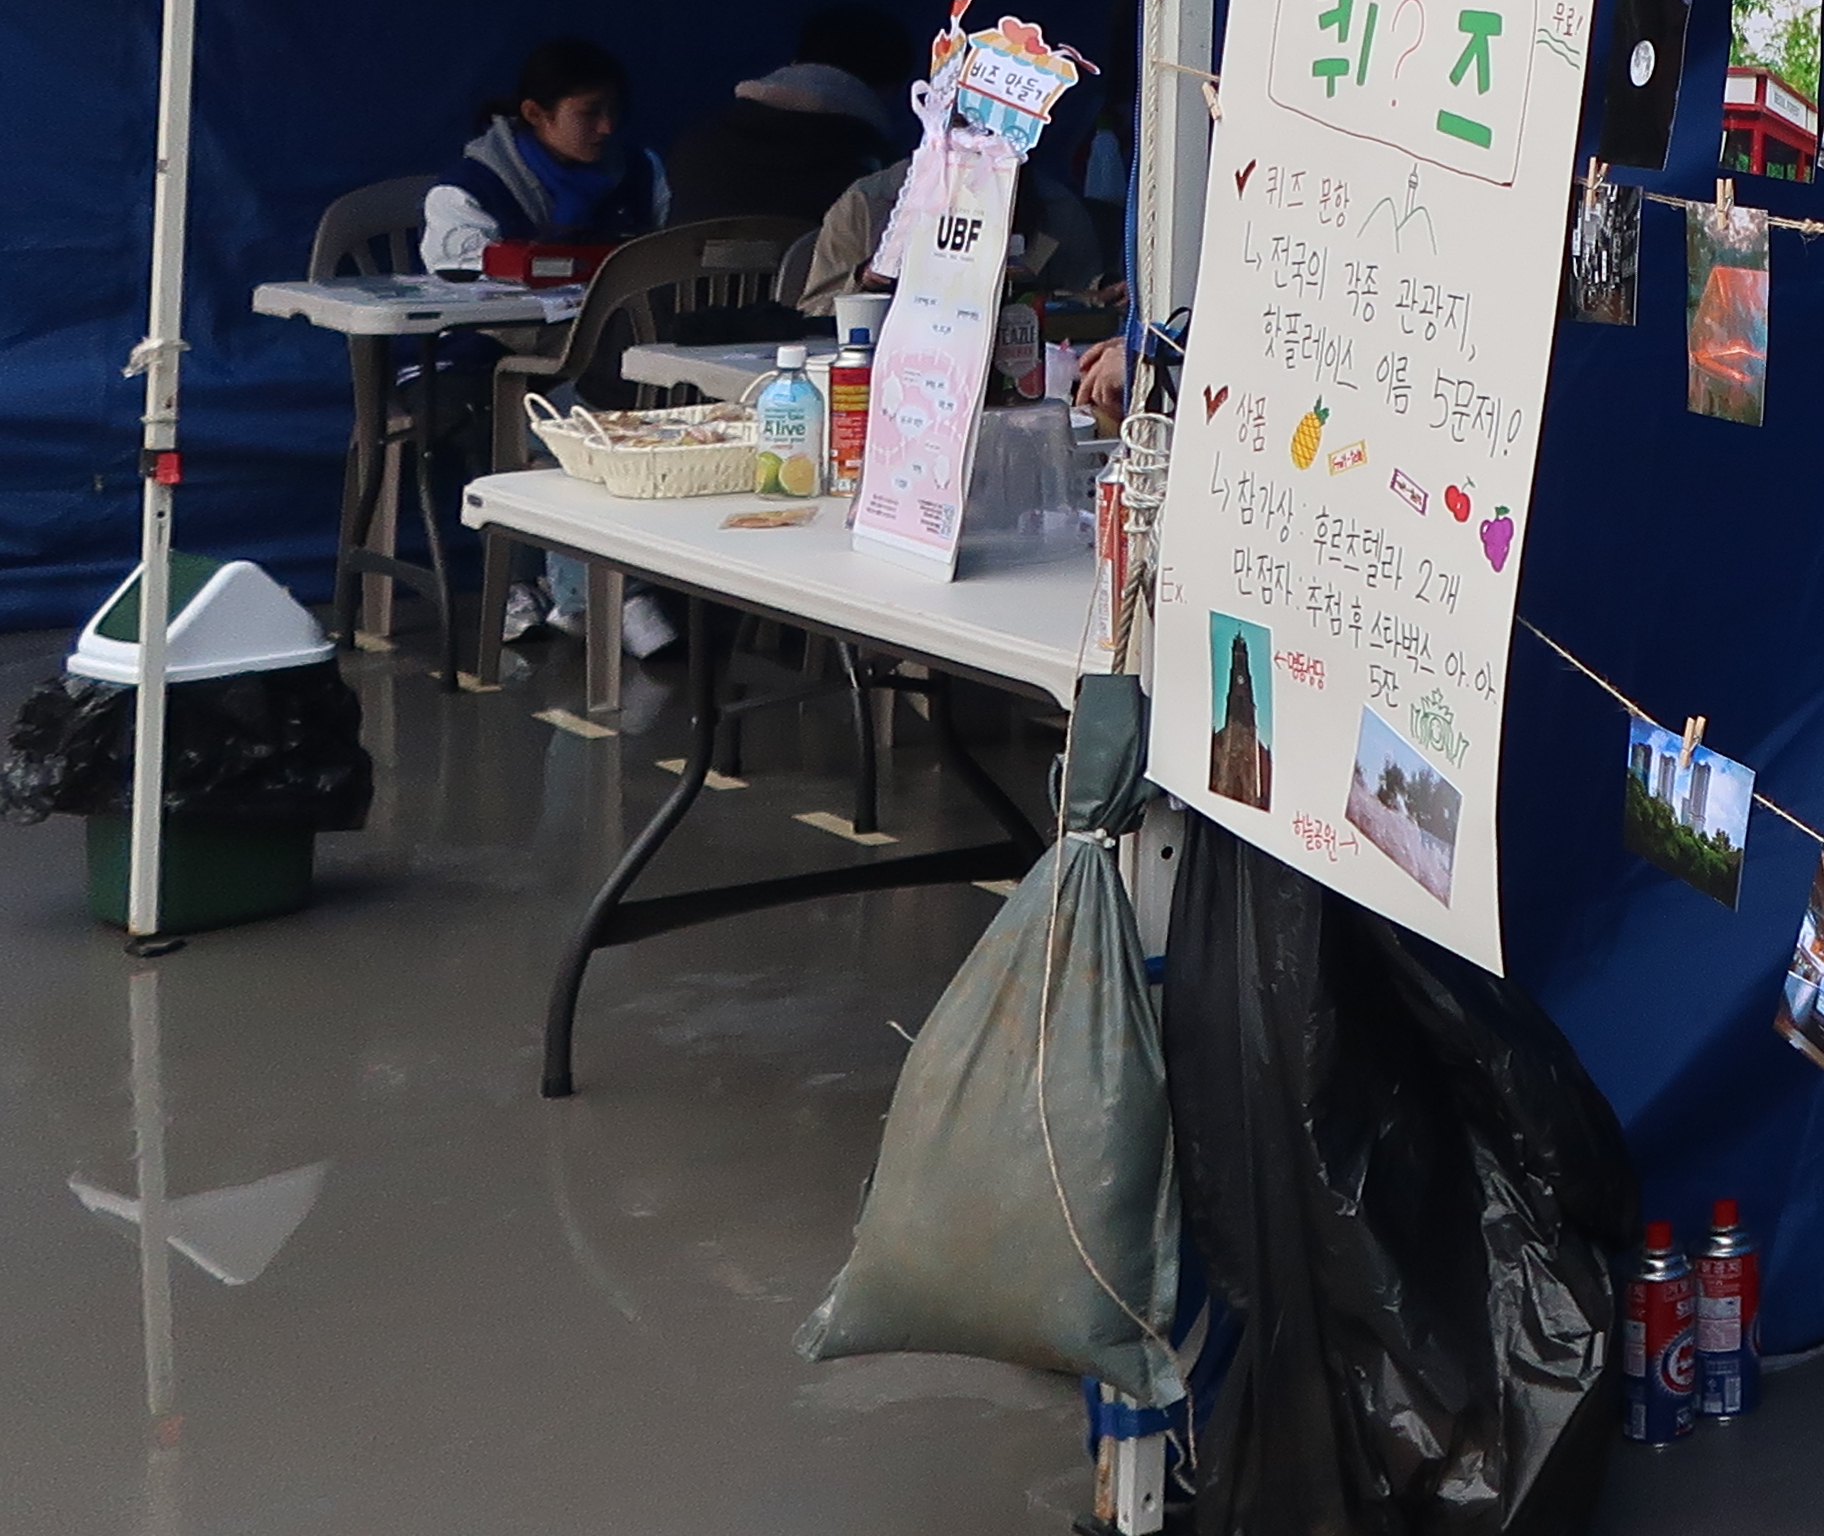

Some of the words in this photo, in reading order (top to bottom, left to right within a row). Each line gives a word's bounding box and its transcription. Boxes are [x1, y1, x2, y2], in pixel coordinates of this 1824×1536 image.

[1553, 2, 1584, 37] 무료!
[1265, 166, 1307, 209] 퀴즈
[1318, 177, 1351, 228] 문항
[936, 215, 982, 253] UBF
[1269, 234, 1328, 301] 전국의
[1345, 261, 1379, 322] 각종
[1262, 303, 1359, 391] 핫플레이스
[1375, 350, 1412, 415] 이름
[763, 419, 806, 436] Alive
[1235, 392, 1267, 453] 상품
[1313, 504, 1404, 590] 후르츠텔라
[1414, 559, 1461, 615] 2개
[1369, 610, 1436, 675] 스타벅스
[1369, 664, 1400, 708] 5잔
[1291, 810, 1339, 863] 하늘공원
